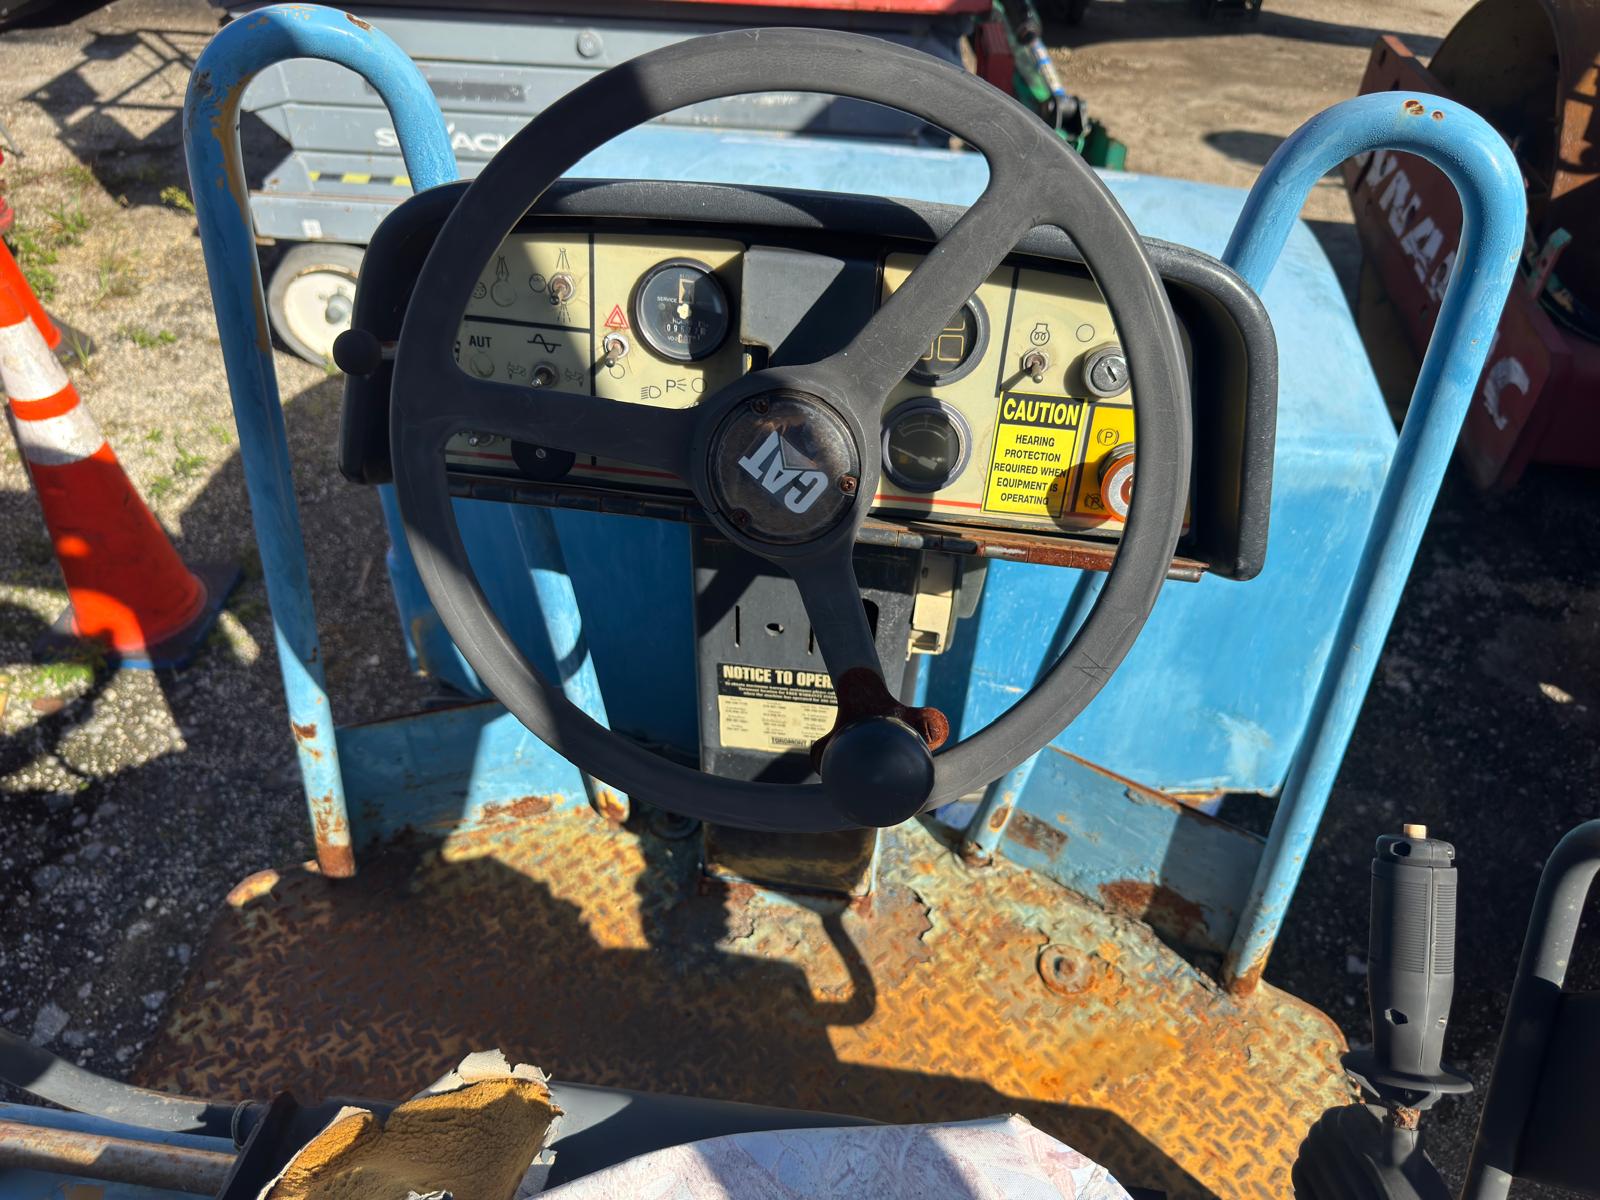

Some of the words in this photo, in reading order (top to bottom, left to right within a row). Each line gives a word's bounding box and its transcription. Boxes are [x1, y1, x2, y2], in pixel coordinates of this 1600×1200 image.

[469, 335, 493, 348] AUT
[1003, 397, 1080, 426] CAUTION
[1015, 434, 1055, 447] HEARING
[1004, 449, 1061, 463] PROTECTION
[737, 430, 829, 514] CAT
[993, 462, 1038, 475] REQUIRED
[1040, 466, 1067, 478] WHEN
[996, 477, 1049, 491] EQUIPMENT
[1050, 482, 1058, 492] IS
[1000, 492, 1049, 506] OPERATING
[723, 664, 772, 683] NOTICE
[775, 670, 793, 685] TO
